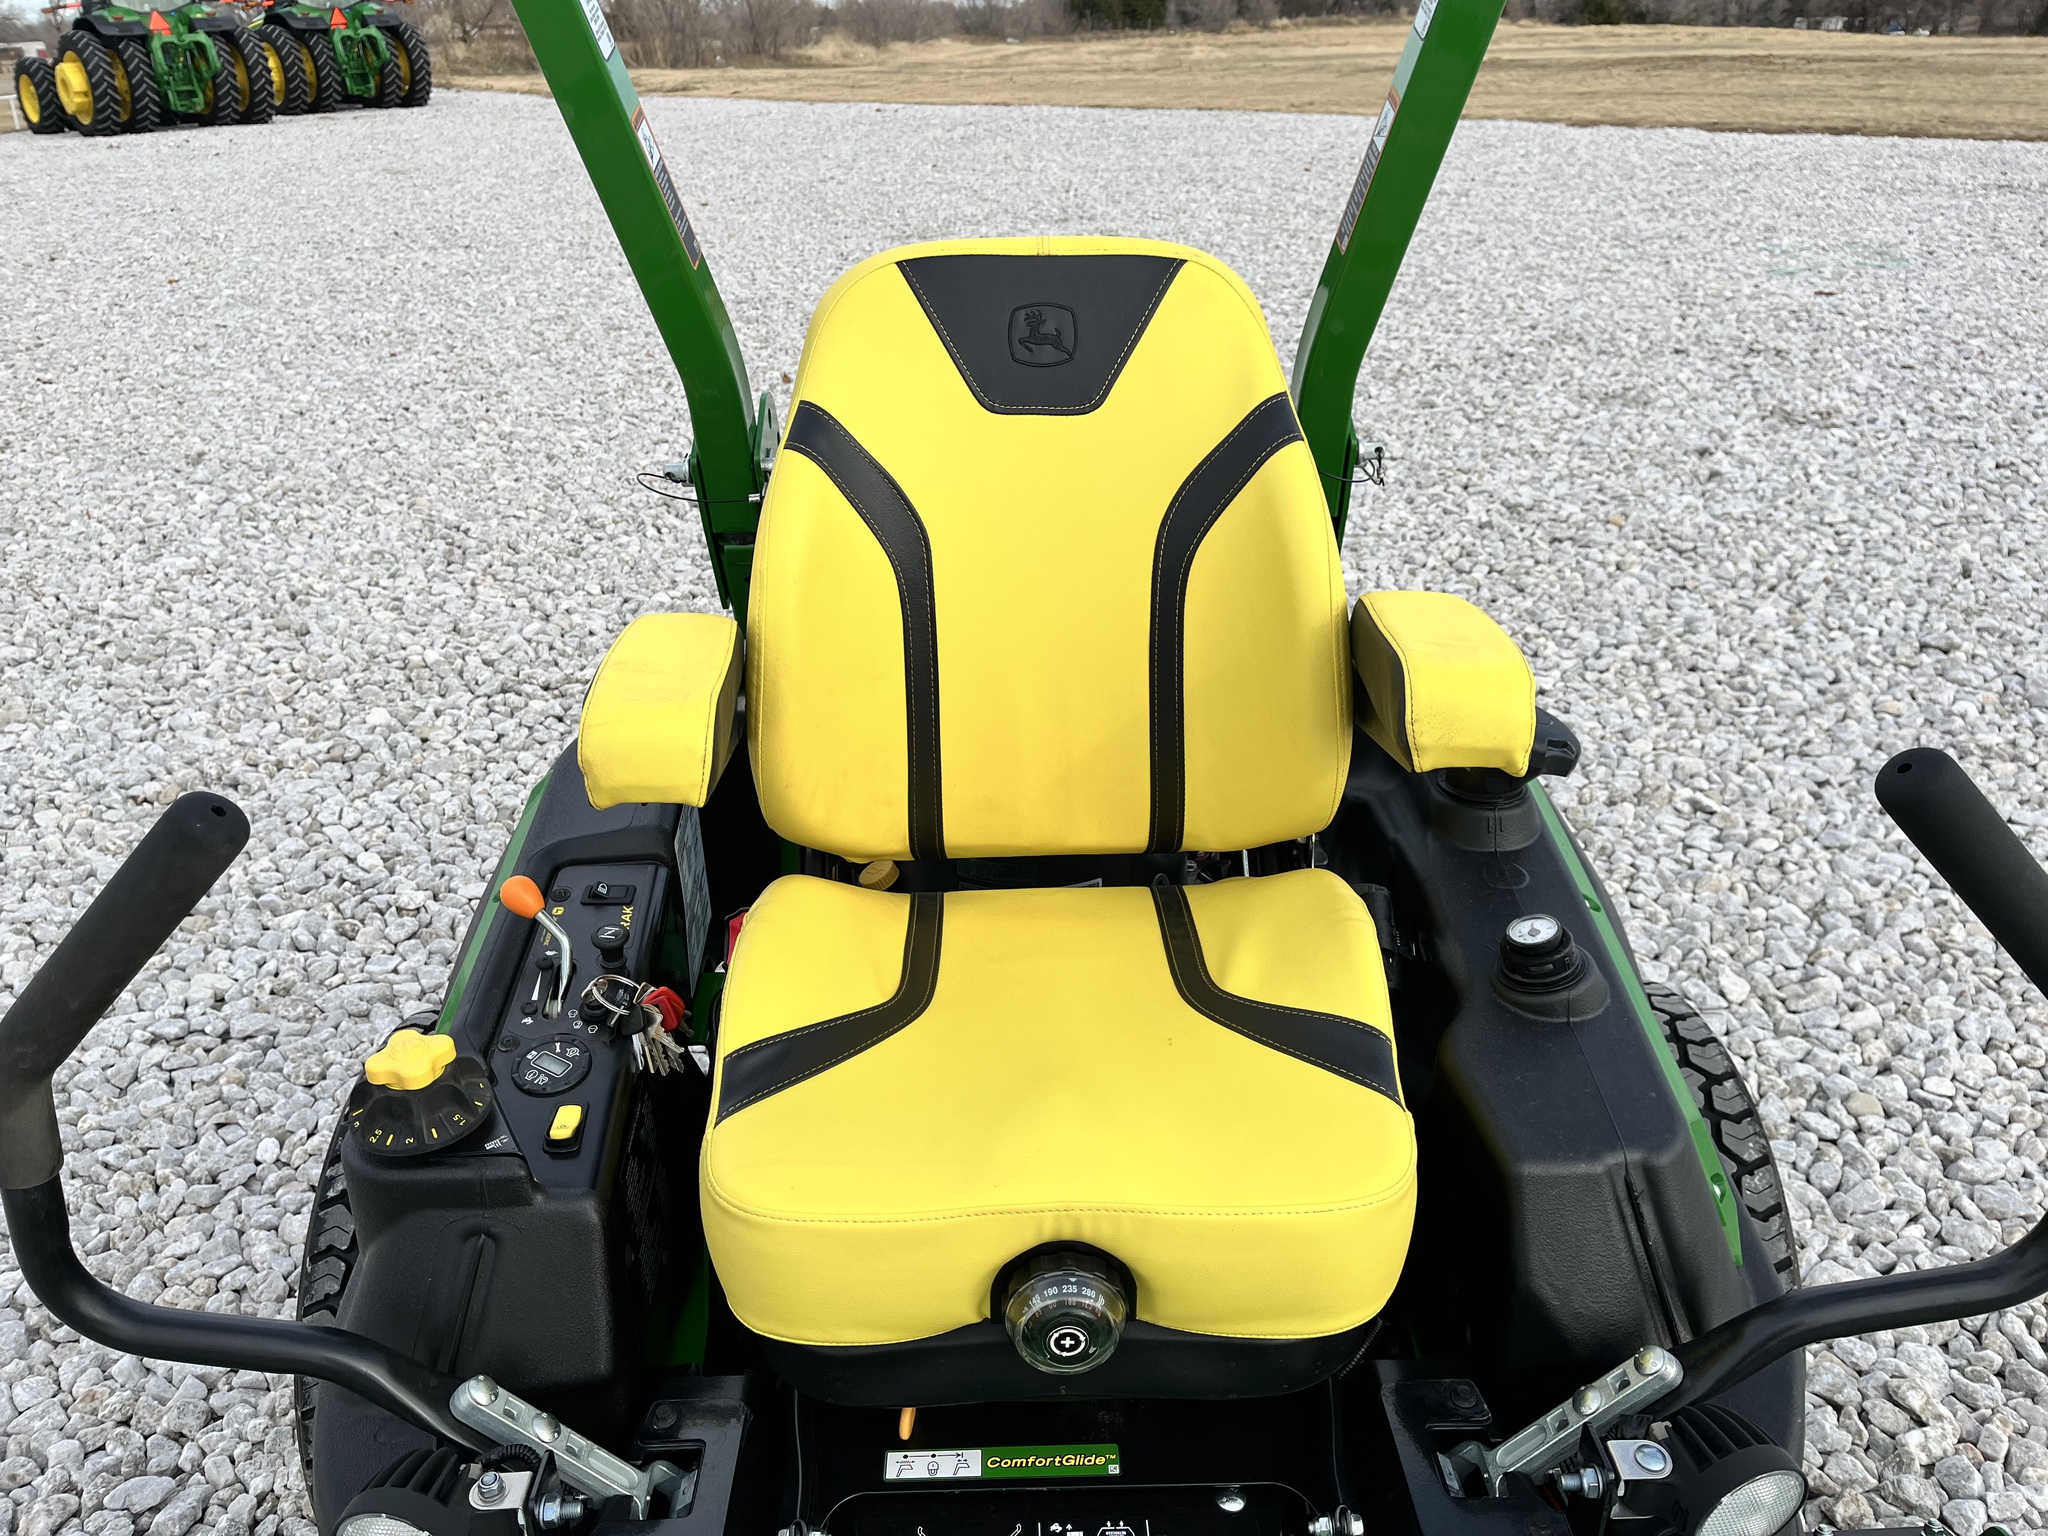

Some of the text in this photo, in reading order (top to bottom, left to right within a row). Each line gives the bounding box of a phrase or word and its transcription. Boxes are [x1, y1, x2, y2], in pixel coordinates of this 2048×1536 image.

[452, 1114, 466, 1126] 1.5
[369, 1129, 383, 1144] 2.5
[405, 1137, 414, 1145] 2
[1043, 1286, 1058, 1298] 190
[1062, 1284, 1078, 1293] 235
[1081, 1287, 1096, 1299] 280
